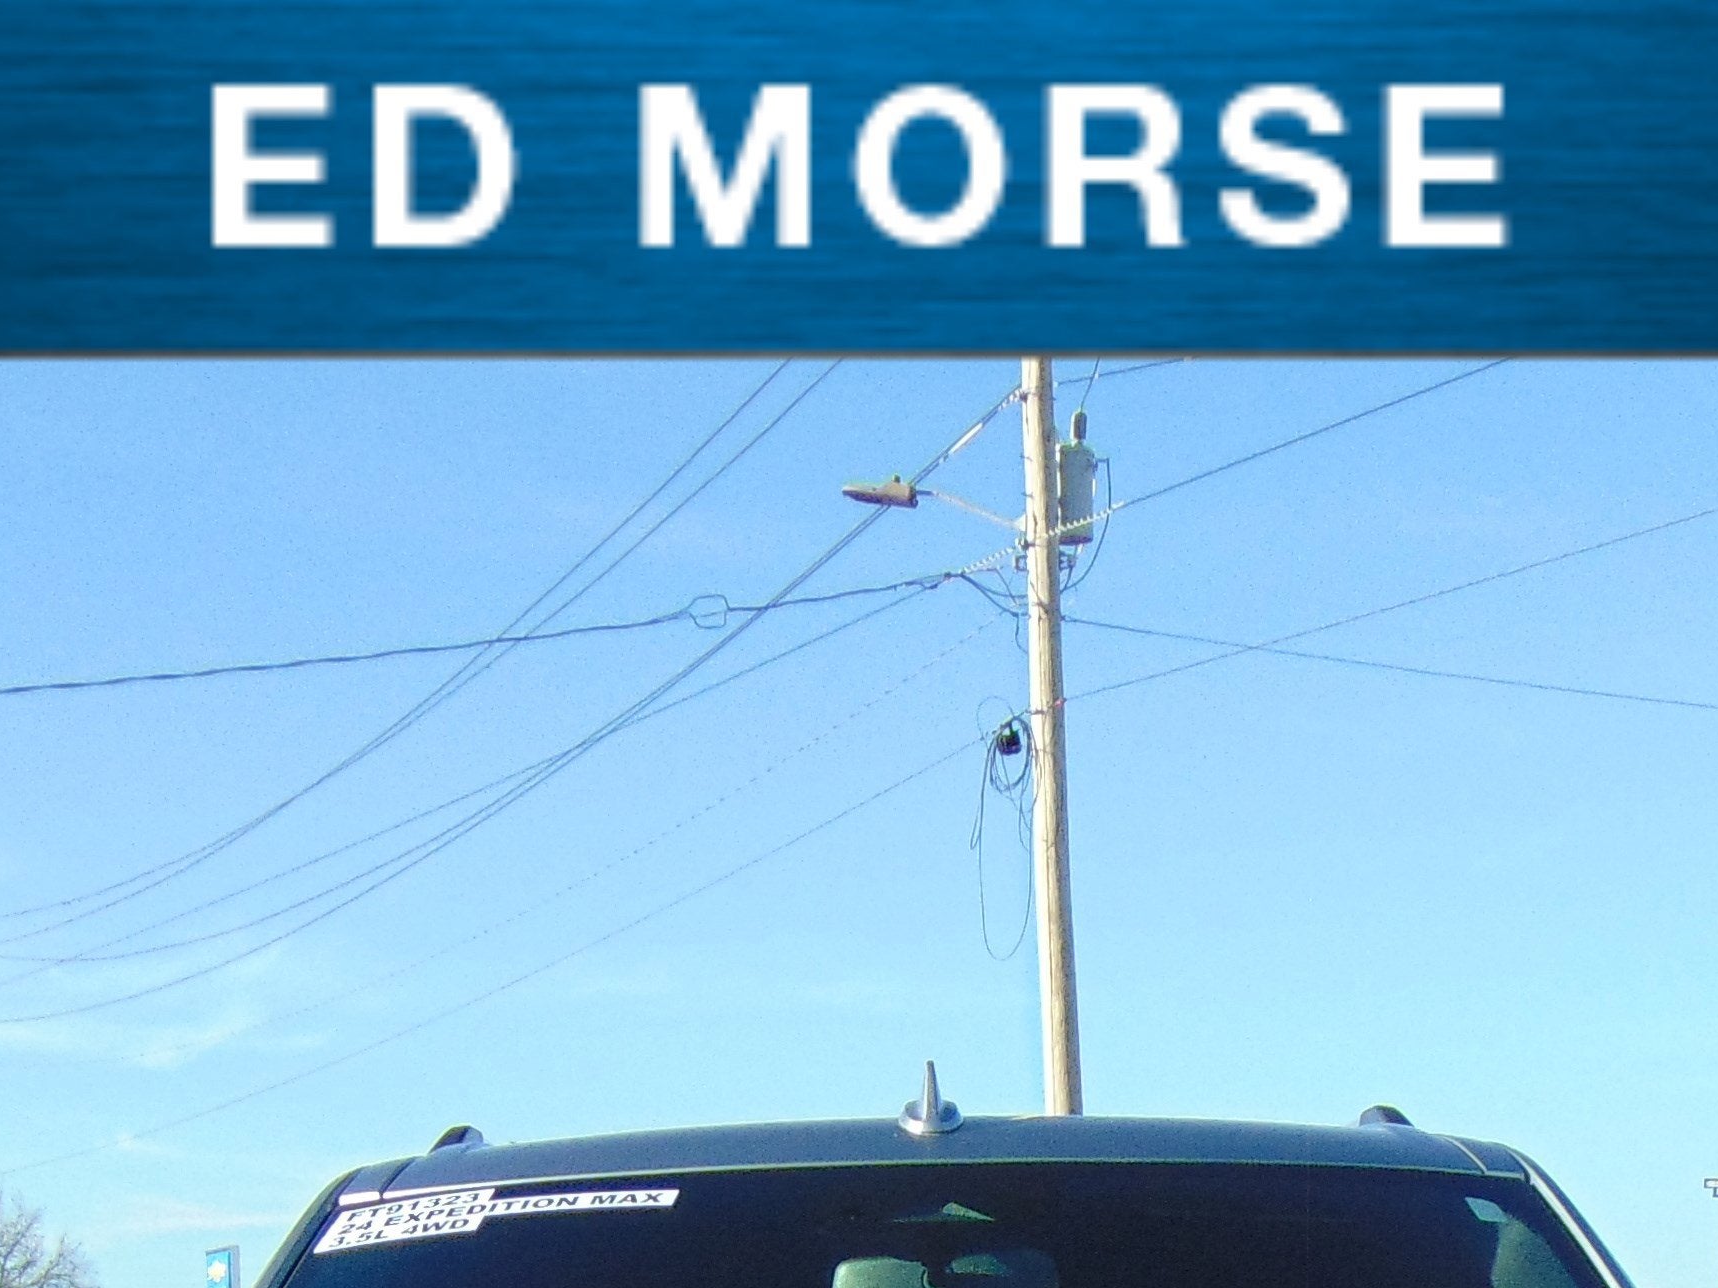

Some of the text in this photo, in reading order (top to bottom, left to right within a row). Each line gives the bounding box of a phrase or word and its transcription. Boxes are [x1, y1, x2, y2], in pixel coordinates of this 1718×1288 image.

[337, 1191, 666, 1236] 24 EXPEDITION MAX
[346, 1192, 481, 1222] FT91323
[328, 1218, 470, 1248] 3.5L 4WD
